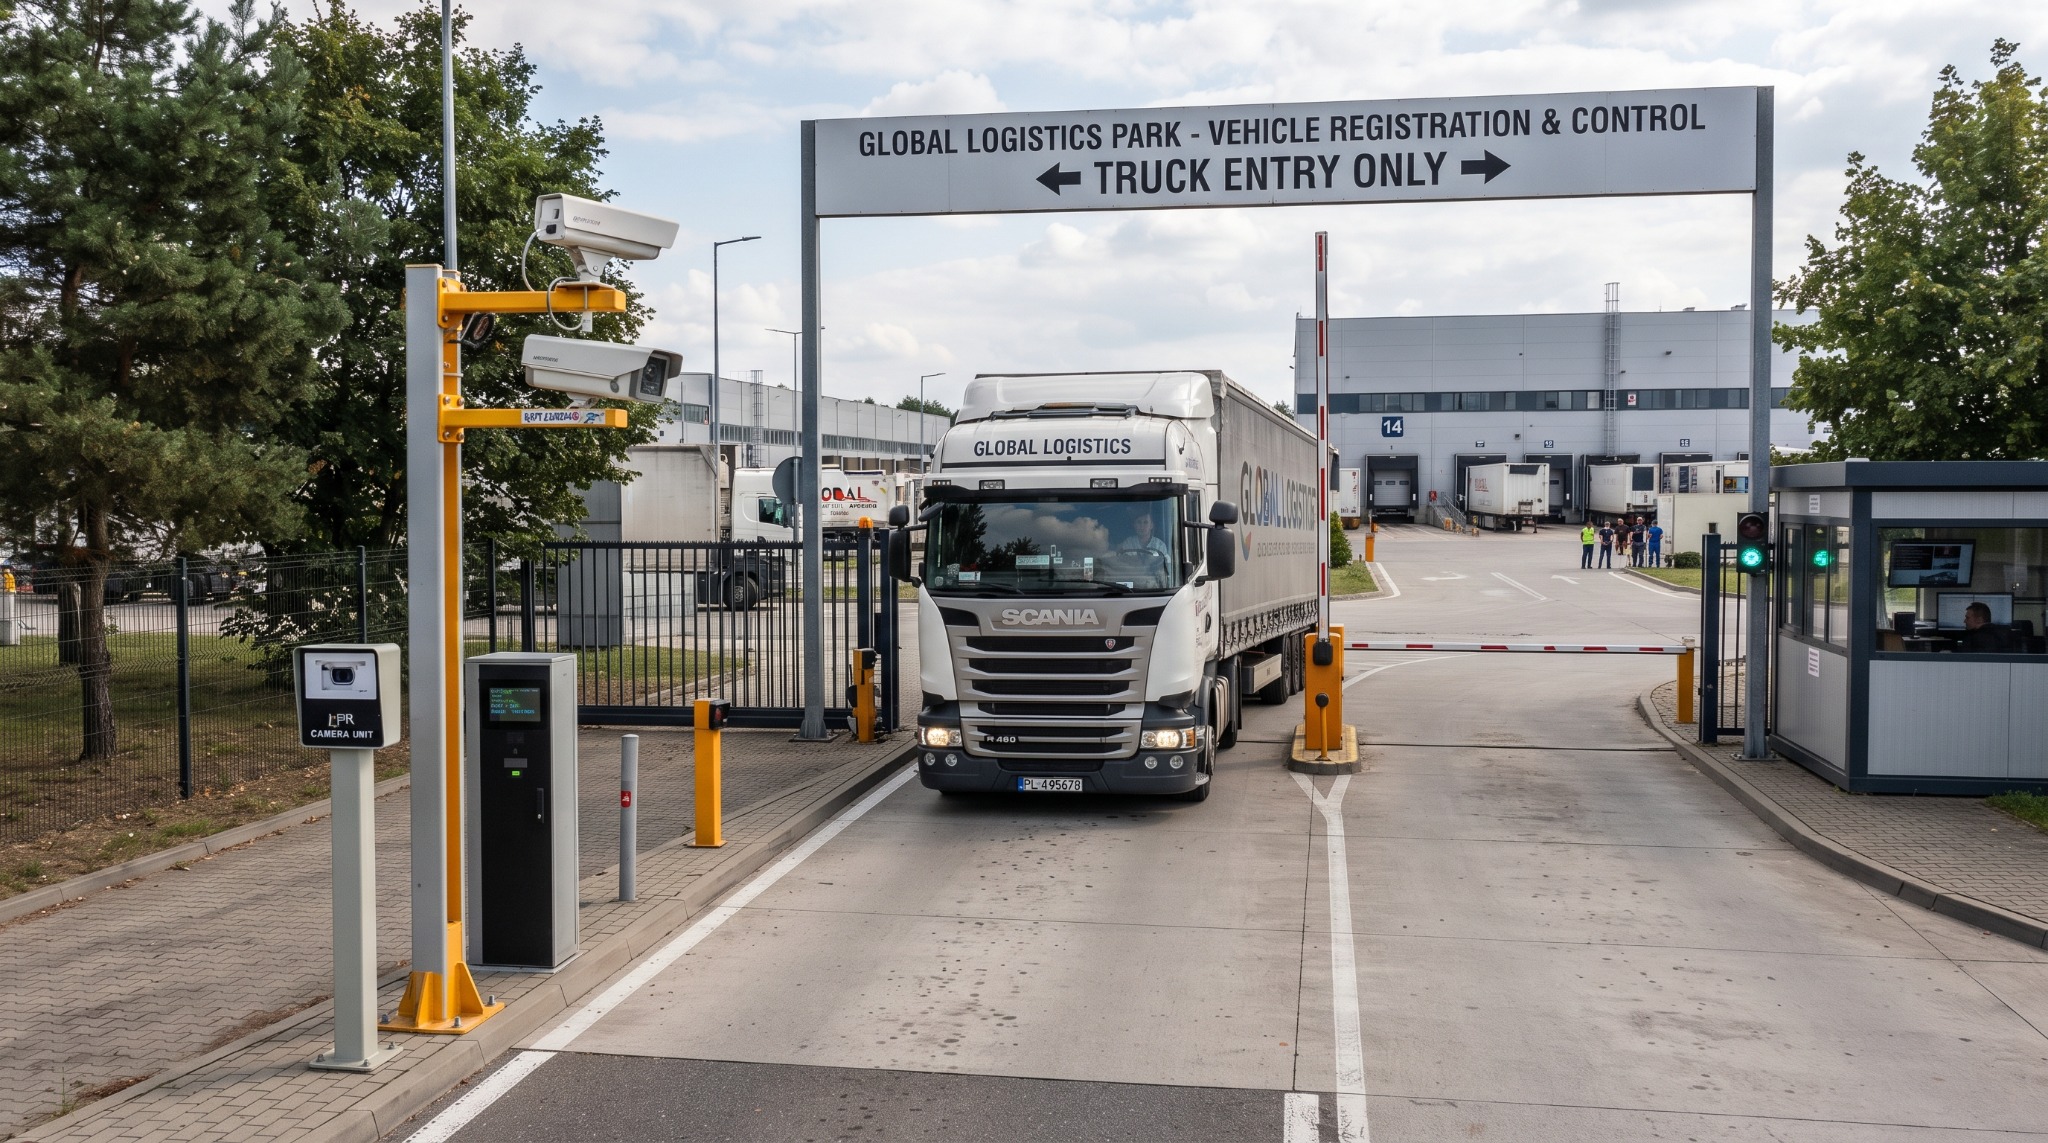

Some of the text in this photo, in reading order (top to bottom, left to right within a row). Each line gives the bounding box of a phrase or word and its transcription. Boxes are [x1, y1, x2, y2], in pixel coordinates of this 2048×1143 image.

[859, 129, 959, 157] GLOBAL
[967, 123, 1103, 154] LOGISTICS
[1112, 120, 1182, 149] PARK
[1208, 116, 1320, 146] VEHICLE
[1330, 109, 1532, 143] REGISTRATION
[1541, 108, 1561, 136] &
[1572, 103, 1706, 135] CONTROL
[1093, 150, 1448, 196] TRUCK ENTRY ONLY
[1383, 419, 1403, 434] 14
[974, 438, 1132, 457] GLOBAL LOGISTICS
[1001, 608, 1100, 626] SCANIA
[310, 729, 374, 739] CAMERA UNIT
